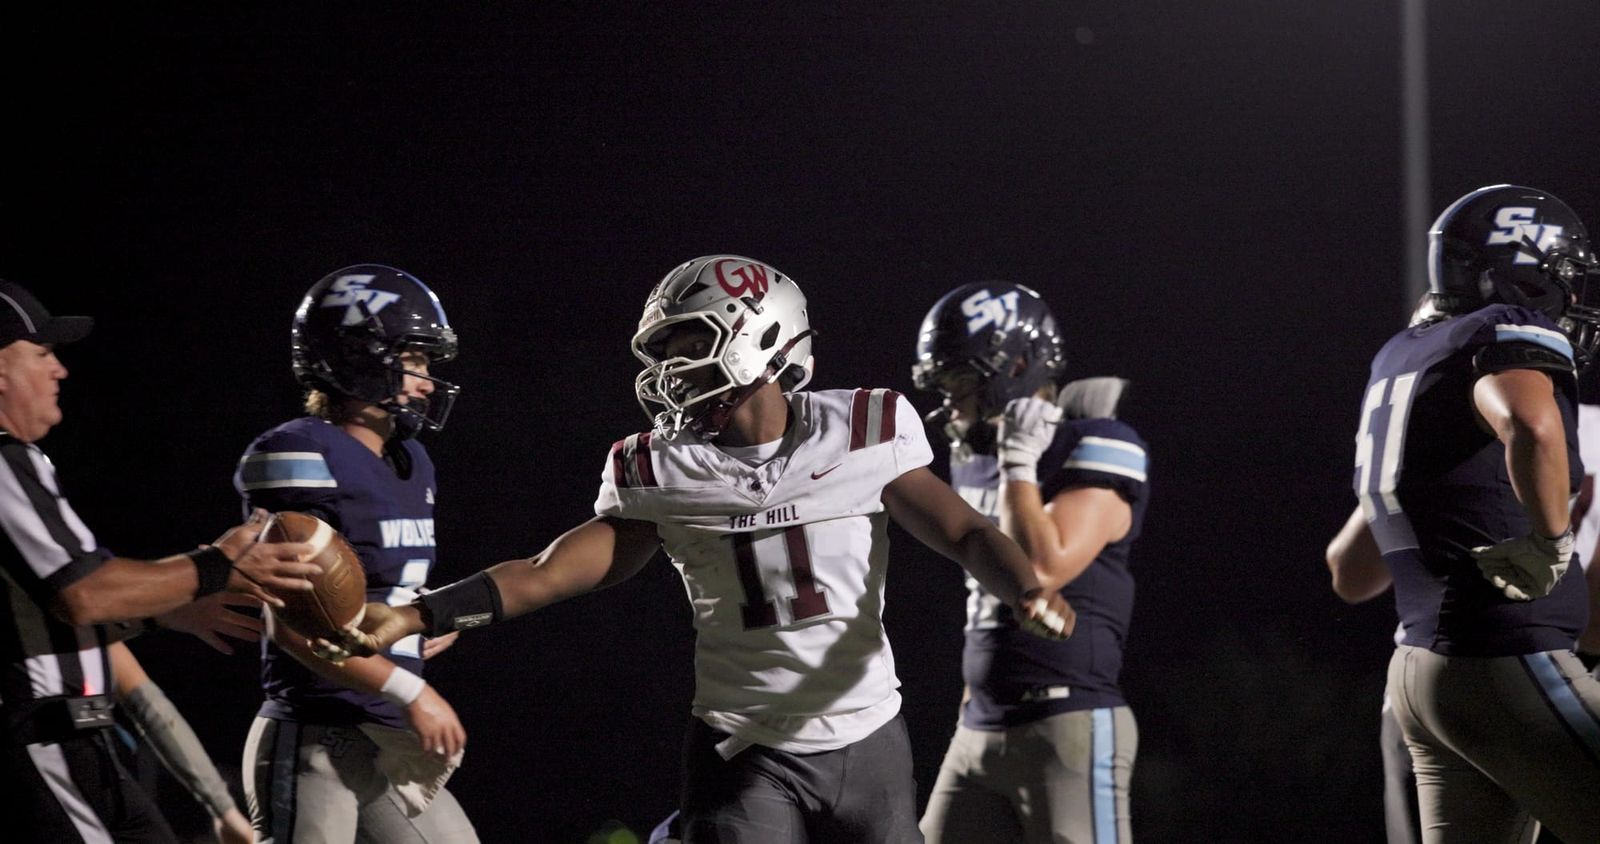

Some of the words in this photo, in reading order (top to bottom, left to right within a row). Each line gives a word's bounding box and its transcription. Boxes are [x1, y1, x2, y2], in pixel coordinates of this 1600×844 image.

[714, 258, 769, 303] GW
[378, 517, 437, 549] WOLVE
[728, 513, 757, 530] THE
[766, 504, 800, 525] HILL
[722, 524, 833, 630] 11
